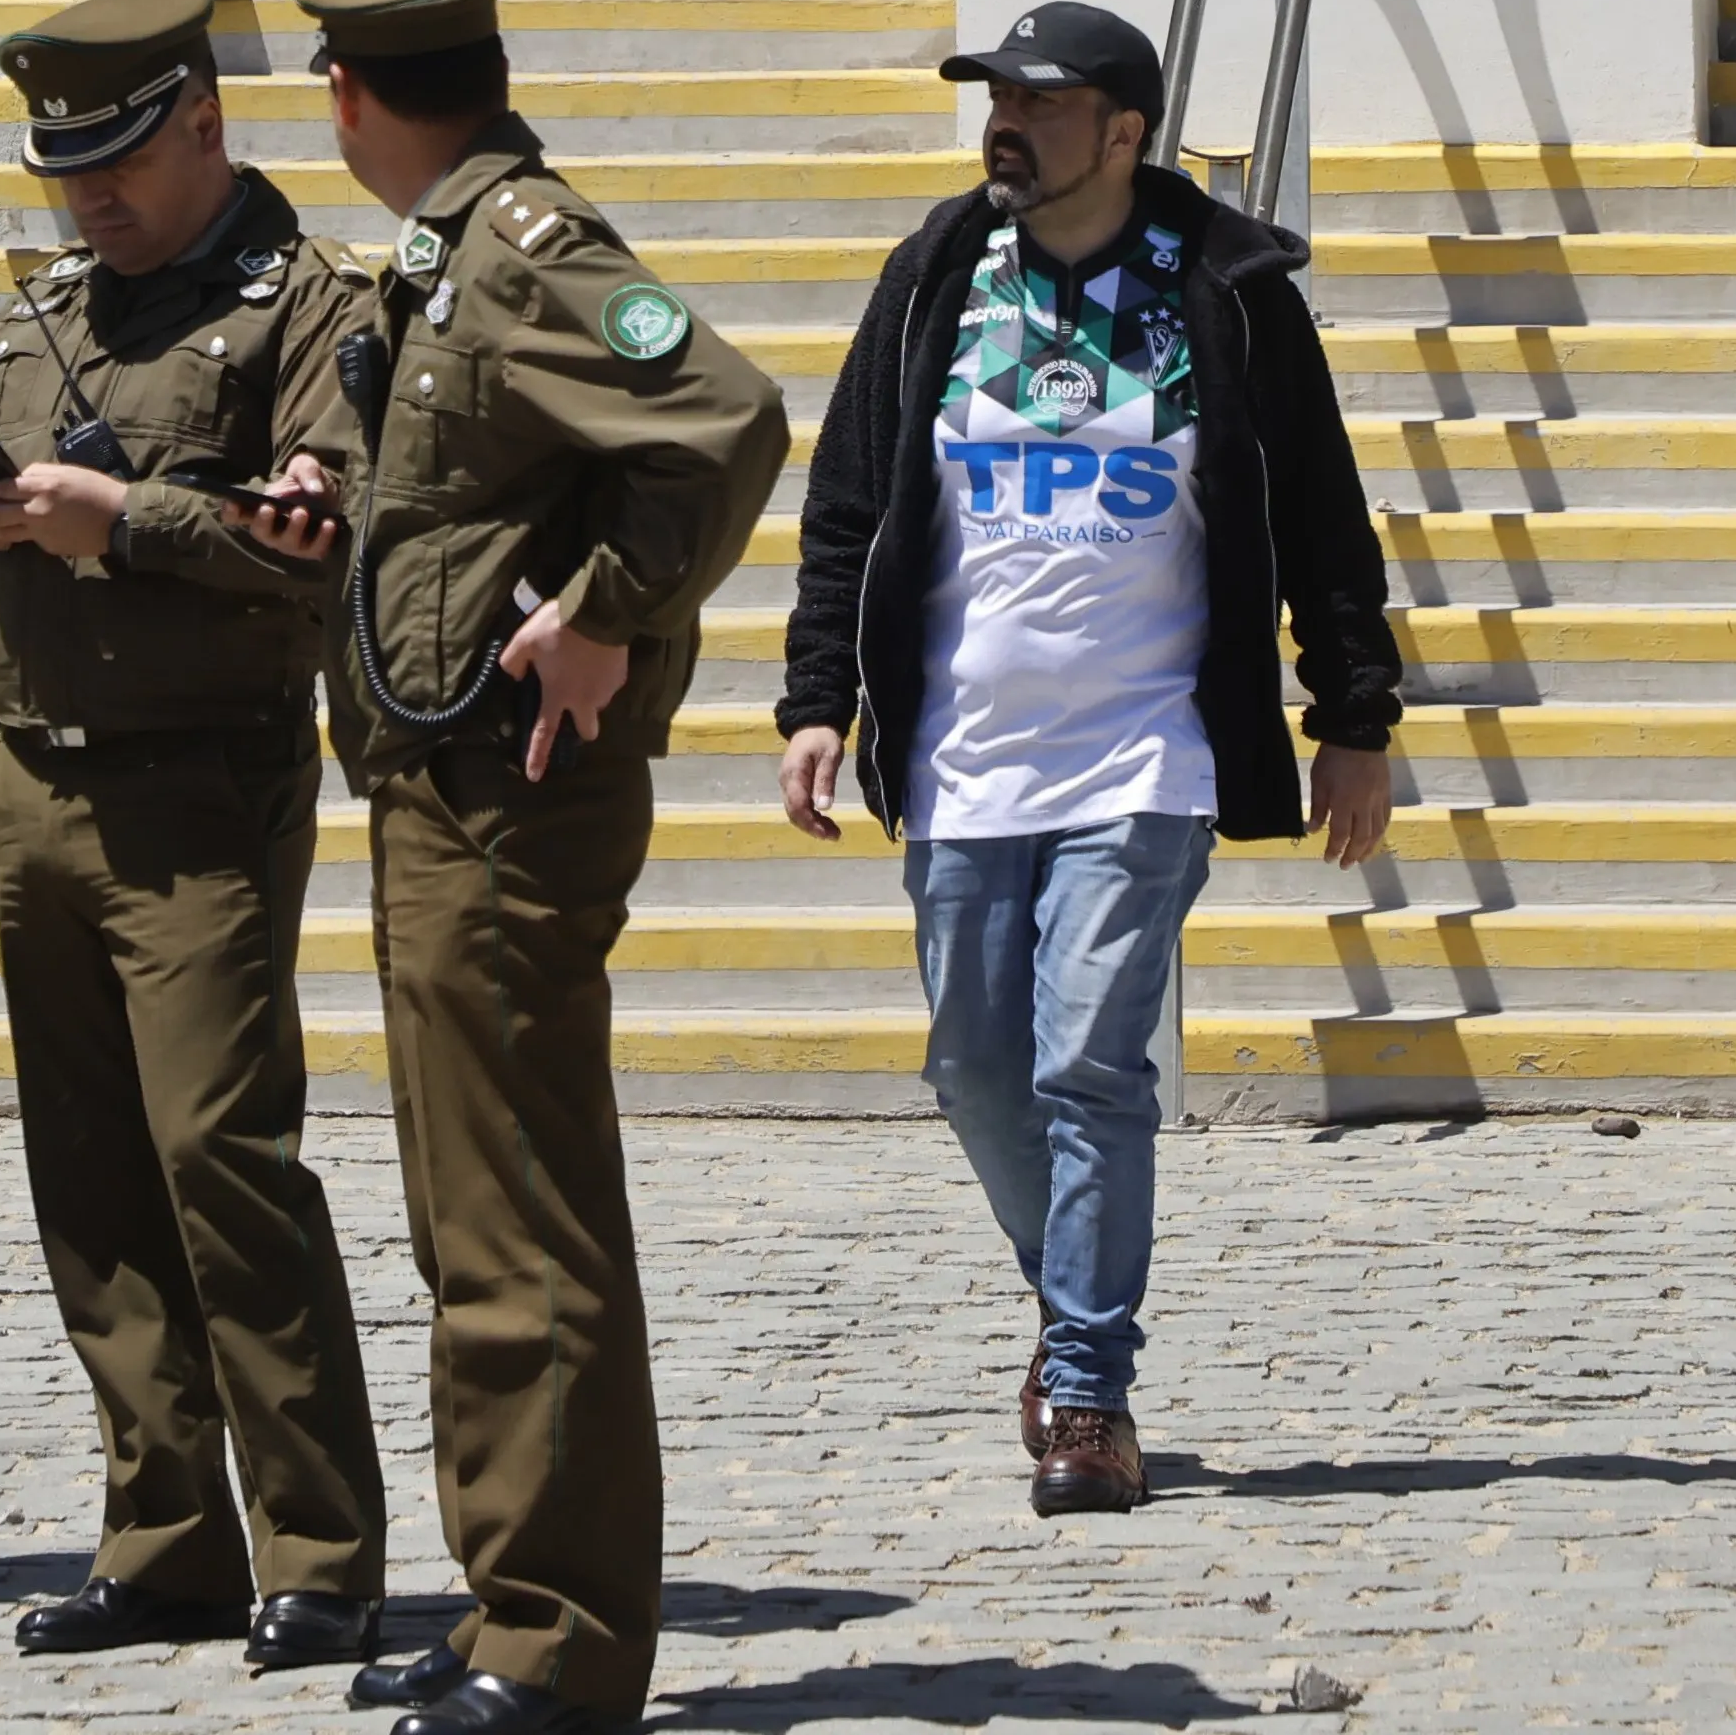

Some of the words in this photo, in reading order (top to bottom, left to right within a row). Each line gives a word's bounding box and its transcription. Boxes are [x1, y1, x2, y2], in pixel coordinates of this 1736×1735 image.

[1039, 380, 1085, 399] 1892
[943, 441, 1180, 520] TPS
[982, 521, 1134, 545] VALPARAÍSO
